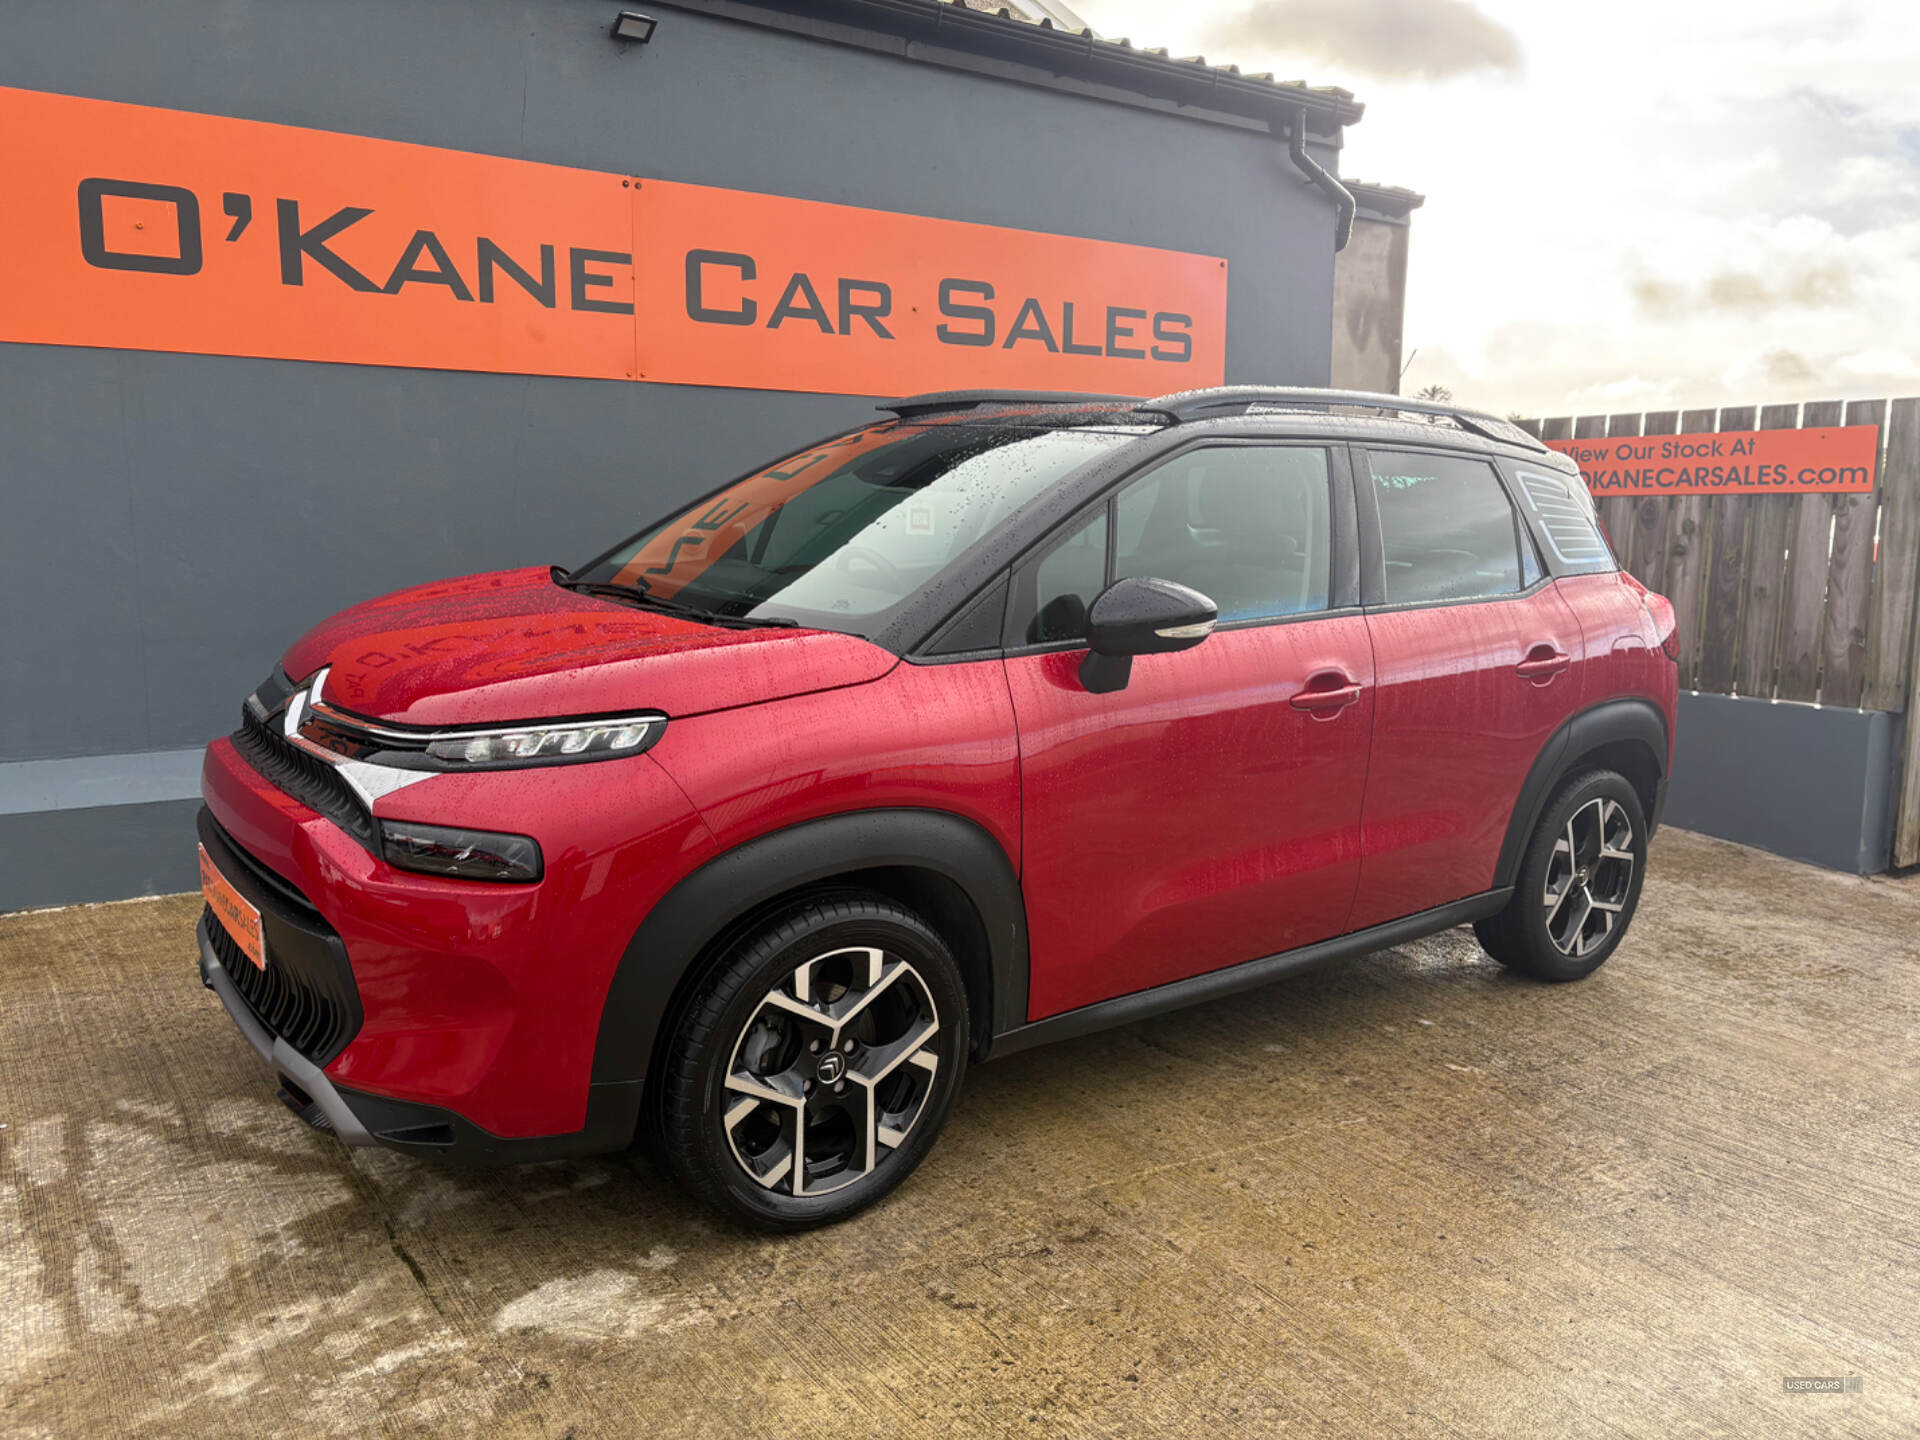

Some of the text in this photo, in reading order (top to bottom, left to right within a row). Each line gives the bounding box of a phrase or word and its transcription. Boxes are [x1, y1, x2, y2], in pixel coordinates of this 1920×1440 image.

[77, 176, 1193, 363] O'KANE CAR SALES
[1562, 437, 1756, 463] View Our Stock At
